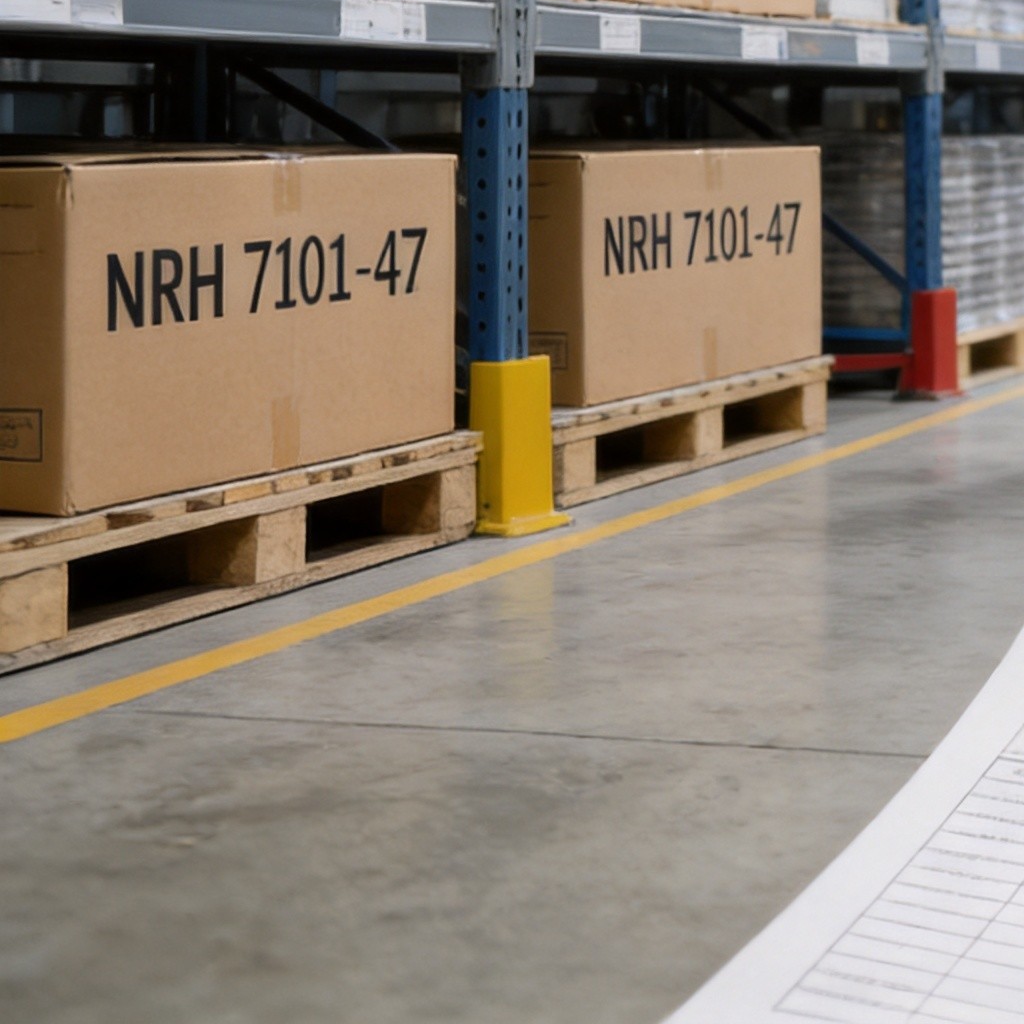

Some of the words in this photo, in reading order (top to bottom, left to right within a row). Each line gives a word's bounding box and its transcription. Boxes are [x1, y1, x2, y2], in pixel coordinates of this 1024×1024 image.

[105, 242, 224, 333] NRH
[243, 226, 428, 315] 7101-47
[603, 211, 672, 278] NRH
[683, 201, 802, 267] 7101-47
